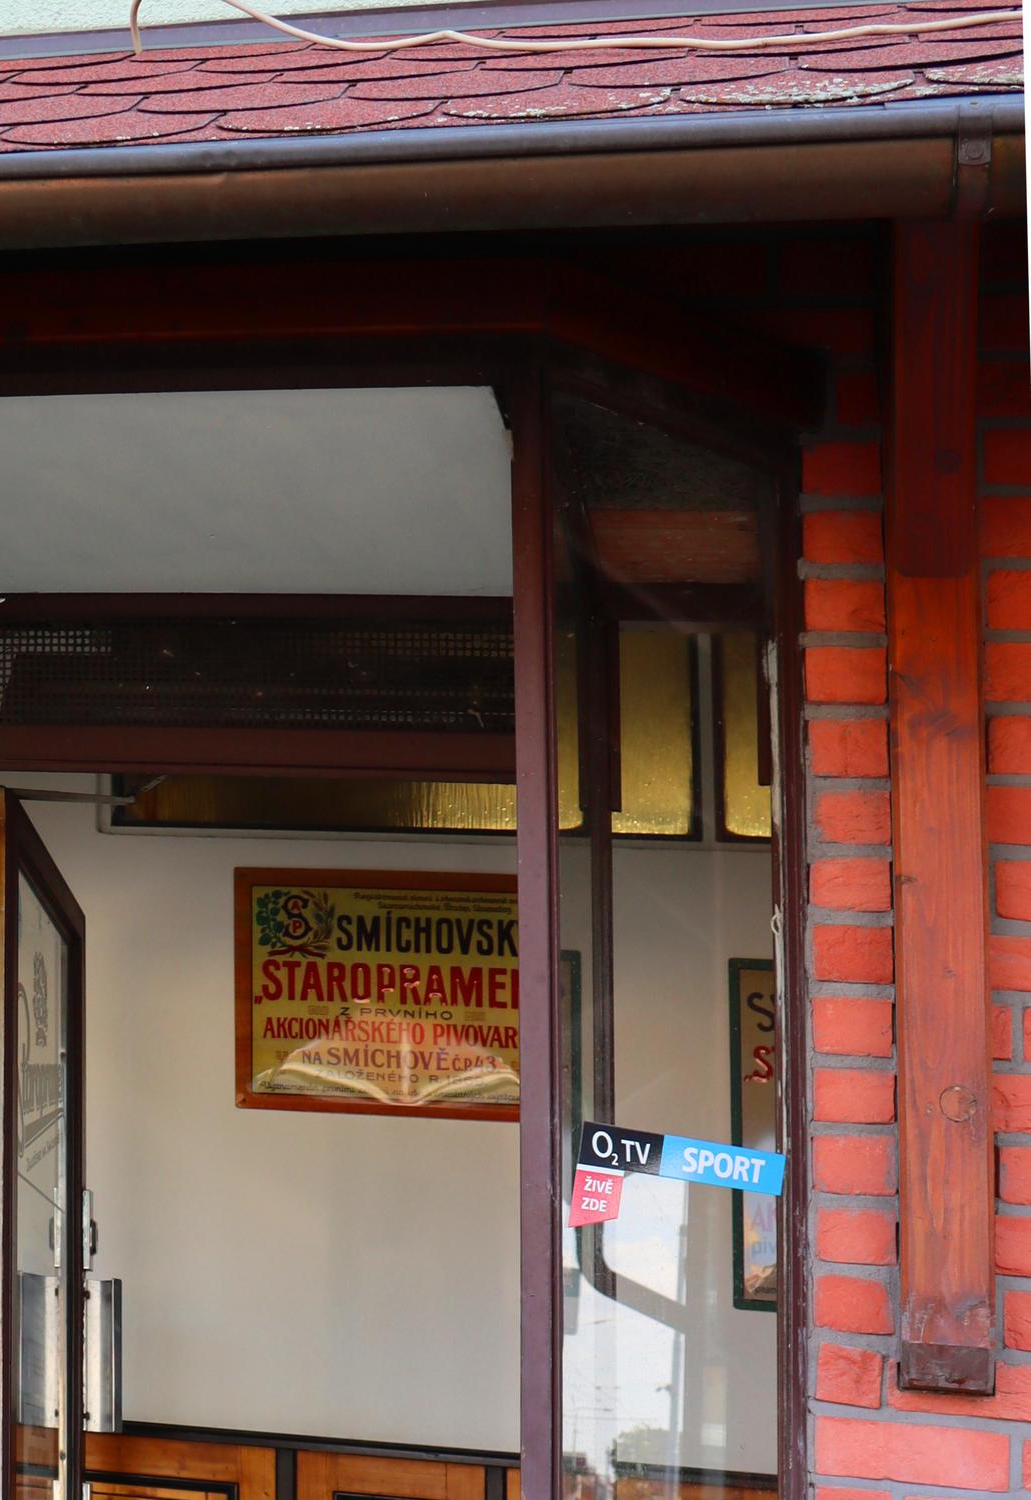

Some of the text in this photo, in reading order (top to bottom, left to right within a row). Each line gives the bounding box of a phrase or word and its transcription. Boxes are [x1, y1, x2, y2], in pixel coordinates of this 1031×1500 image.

[336, 911, 518, 957] SMÍCHOVSK
[340, 1006, 454, 1021] Z PRVNÍHO
[263, 1016, 425, 1046] AKCIONÁŘSKÉHO
[301, 1051, 322, 1066] NA
[327, 1044, 450, 1071] SMÍCHOVĚ
[621, 1139, 651, 1165] TV
[681, 1147, 766, 1184] SPORT
[583, 1176, 614, 1195] ŽIVĚ
[581, 1197, 607, 1213] ZDE
